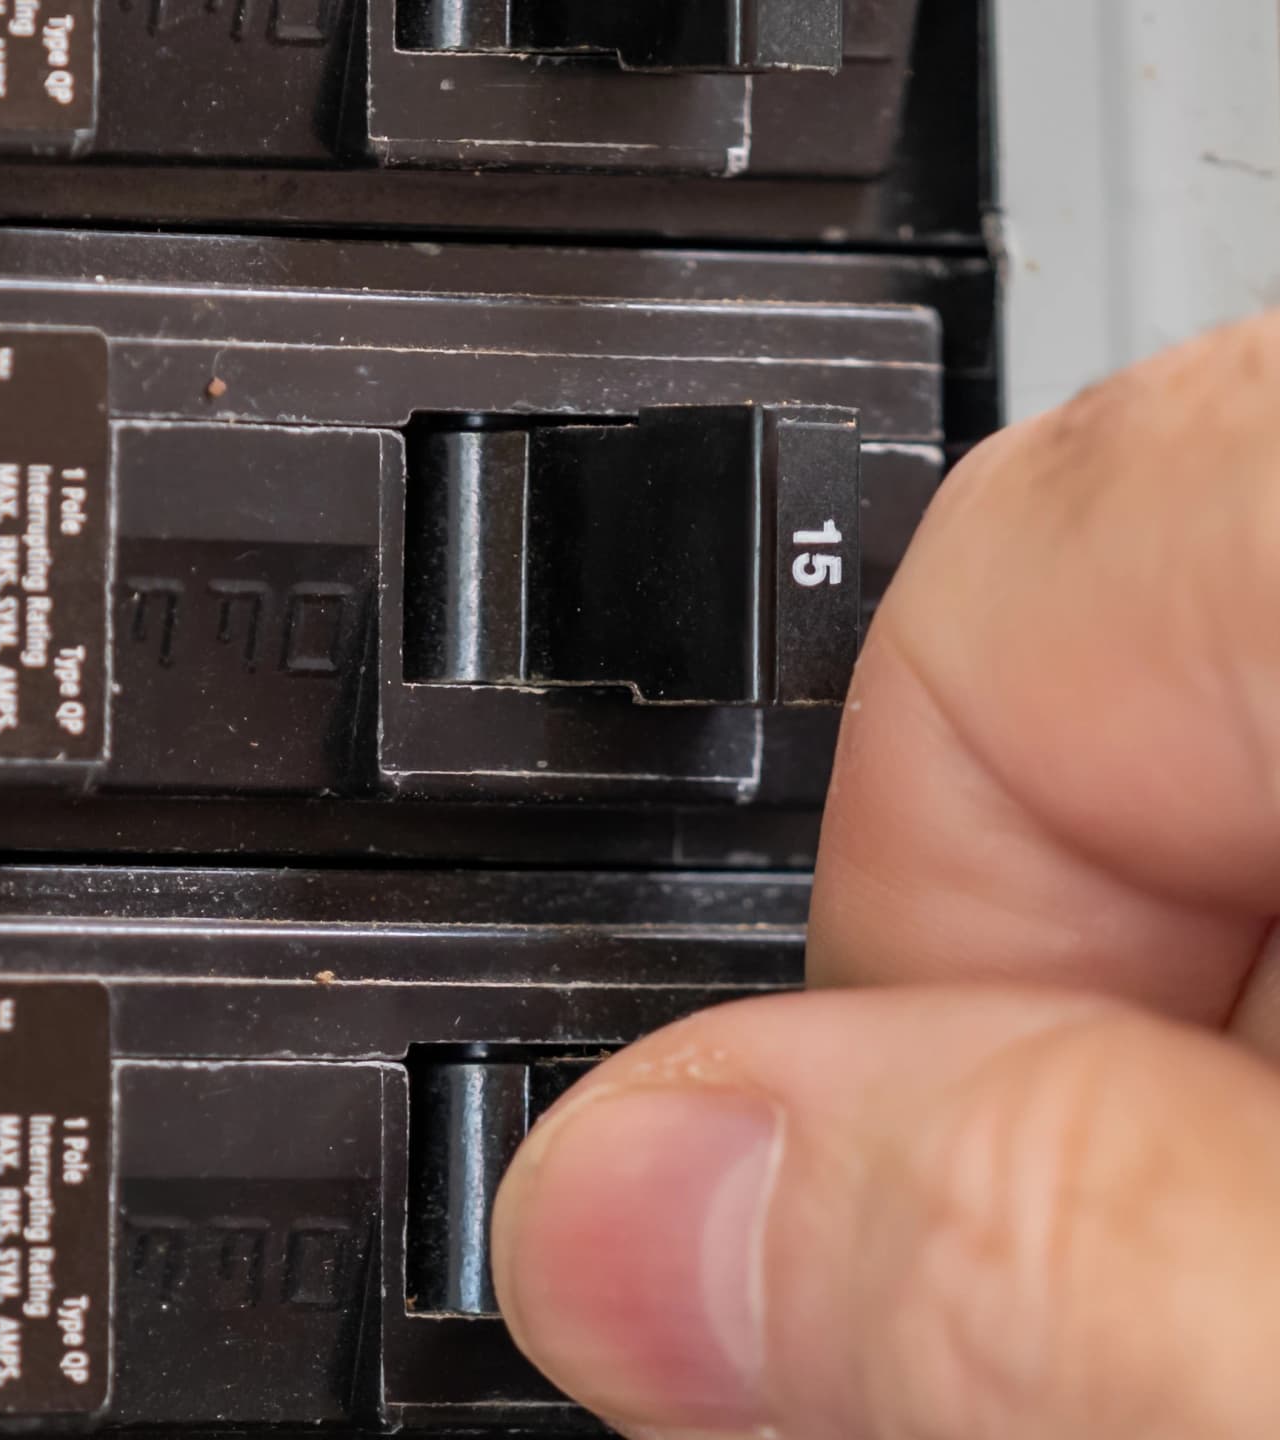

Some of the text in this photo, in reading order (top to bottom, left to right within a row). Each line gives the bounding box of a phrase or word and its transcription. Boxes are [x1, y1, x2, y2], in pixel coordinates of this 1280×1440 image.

[43, 15, 74, 104] Type QP
[61, 468, 86, 534] 1 Pole
[21, 465, 52, 667] Interrupting Rating
[792, 519, 842, 586] 15
[54, 645, 85, 734] Type QP
[63, 1118, 89, 1183] 1 Pole
[23, 1115, 54, 1317] Interrupting Rating
[58, 1296, 89, 1383] Type QP
